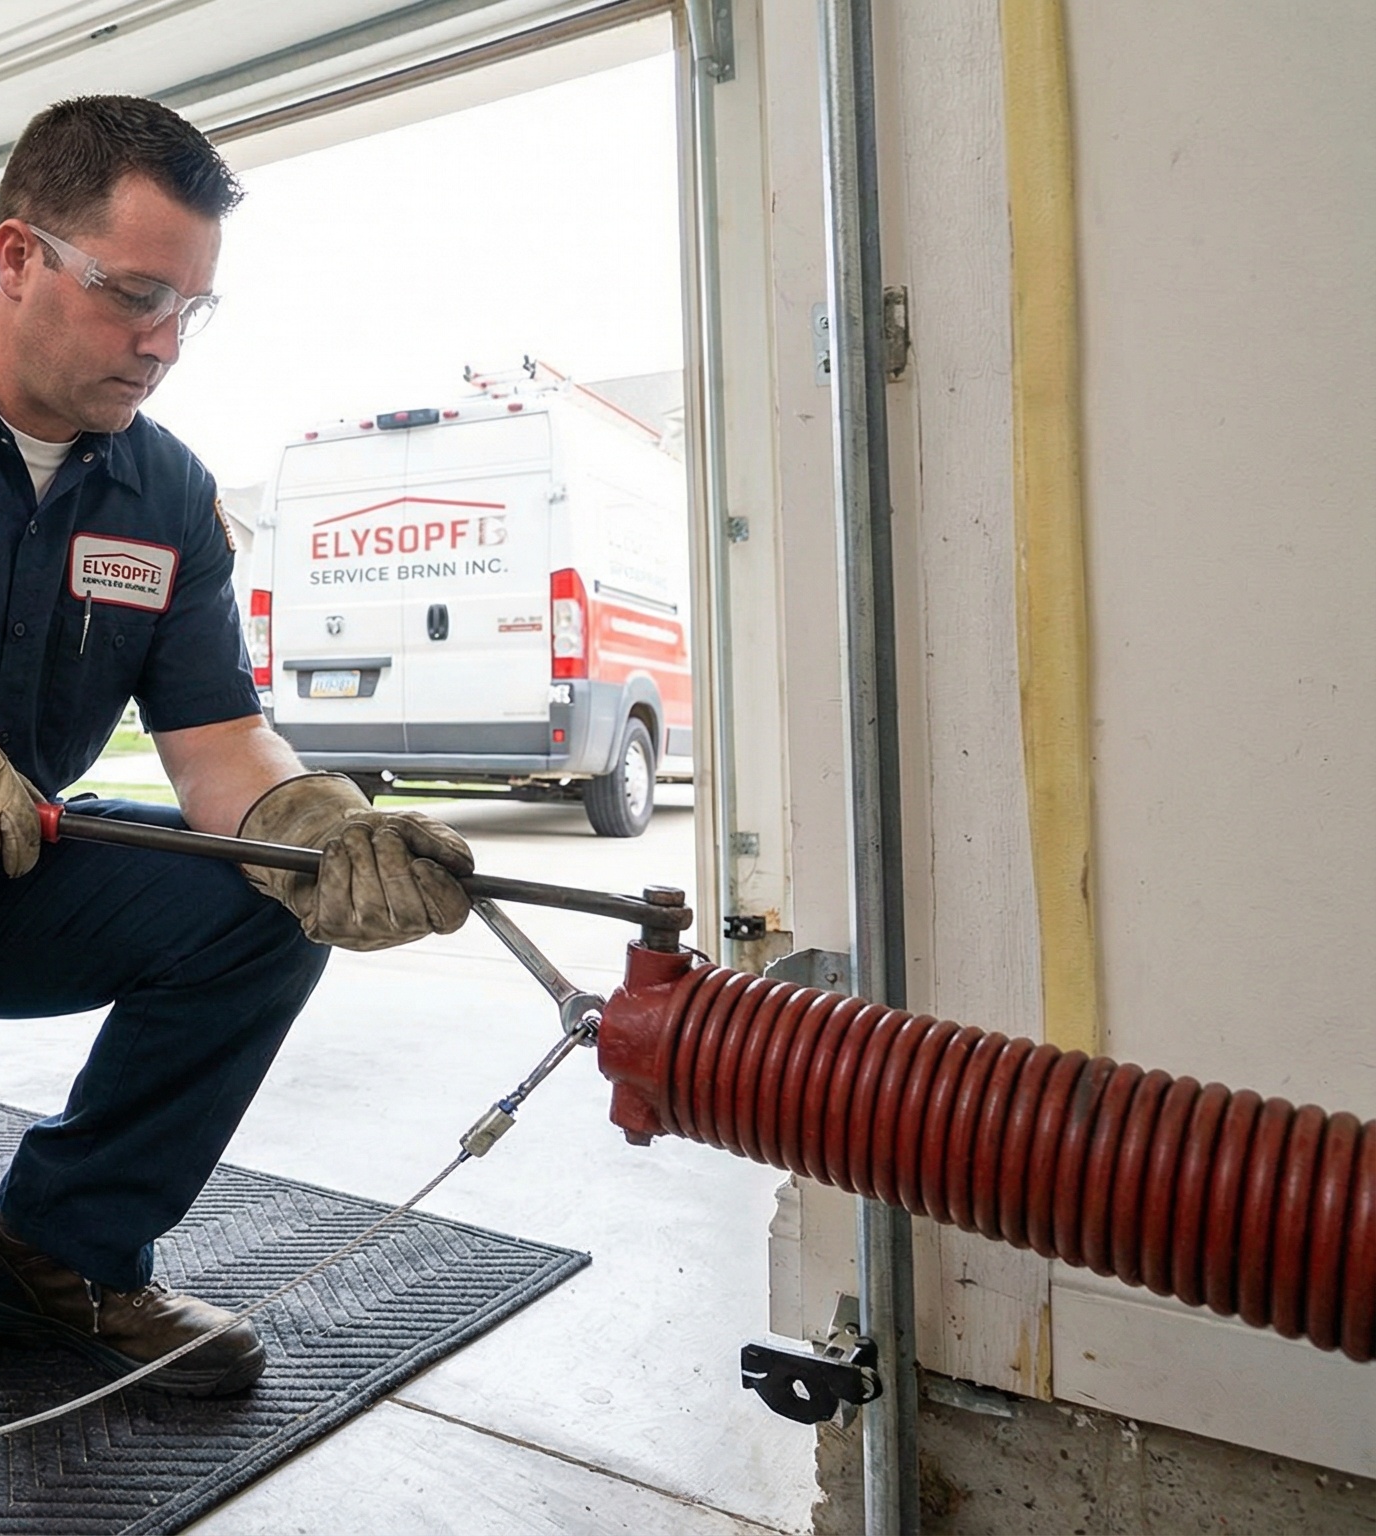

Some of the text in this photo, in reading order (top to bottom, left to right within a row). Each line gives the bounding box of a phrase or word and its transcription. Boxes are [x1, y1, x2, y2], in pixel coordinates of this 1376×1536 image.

[310, 558, 509, 585] SERVICE BRNN INC.
